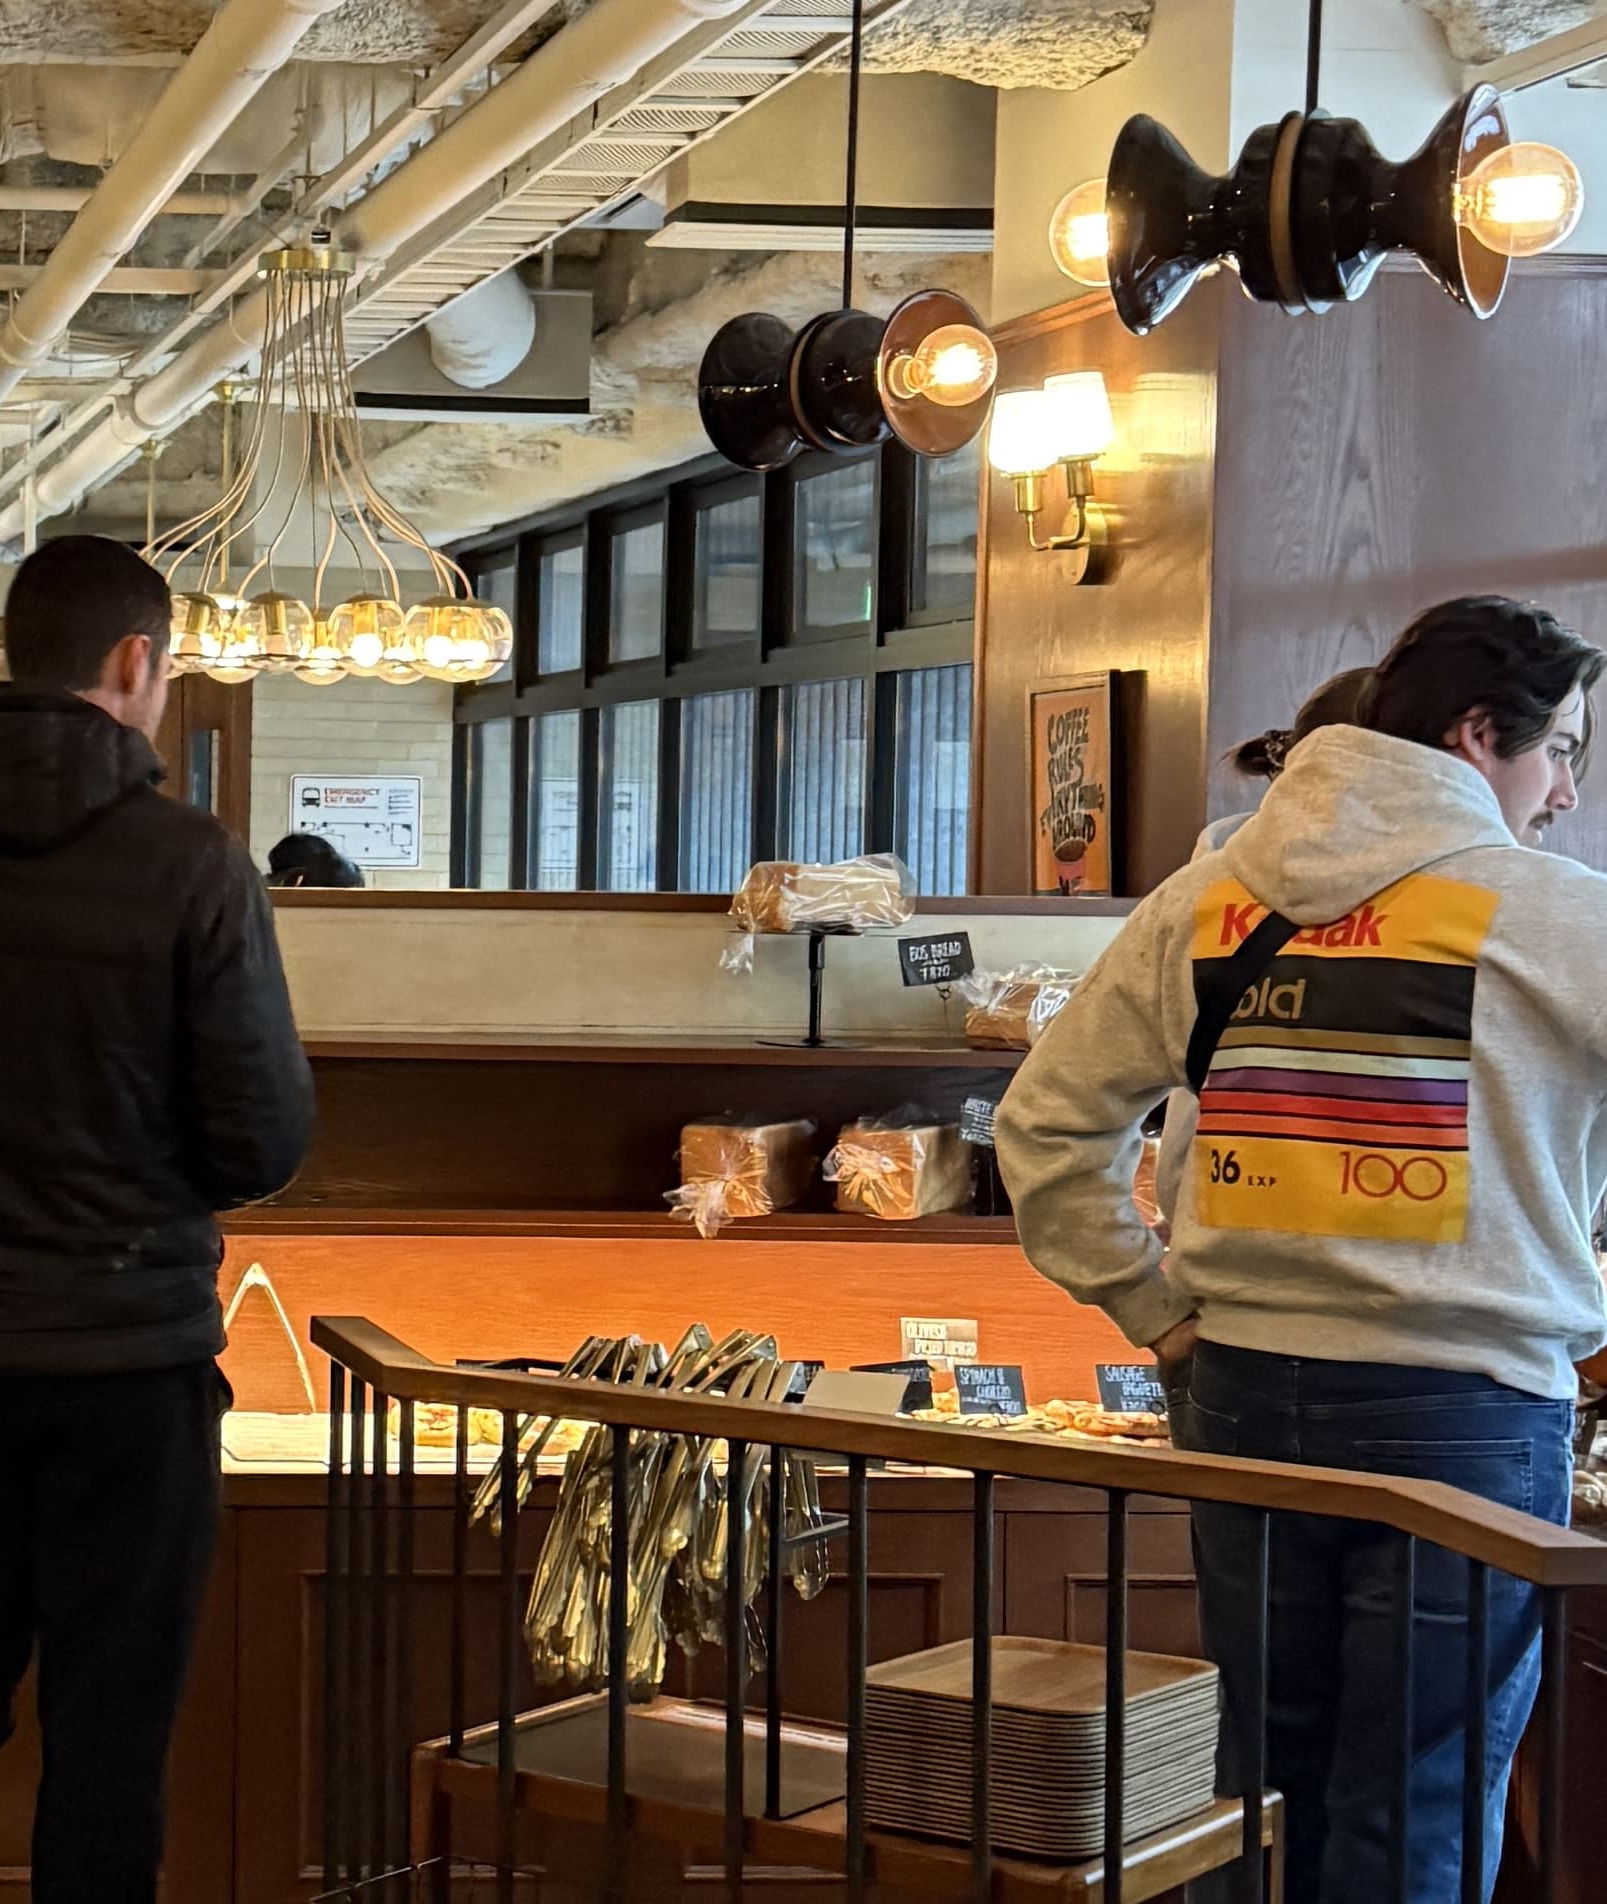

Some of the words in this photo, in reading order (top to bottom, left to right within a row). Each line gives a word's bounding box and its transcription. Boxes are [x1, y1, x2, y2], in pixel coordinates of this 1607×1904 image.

[1047, 706, 1090, 756] COFFEE
[1048, 747, 1084, 788] RULES
[1219, 903, 1390, 947] Kak
[1232, 978, 1306, 1020] old
[1210, 1149, 1241, 1185] 36
[1247, 1175, 1277, 1186] EXP
[1340, 1151, 1447, 1201] 100
[1104, 1365, 1145, 1383] SAUSAGE
